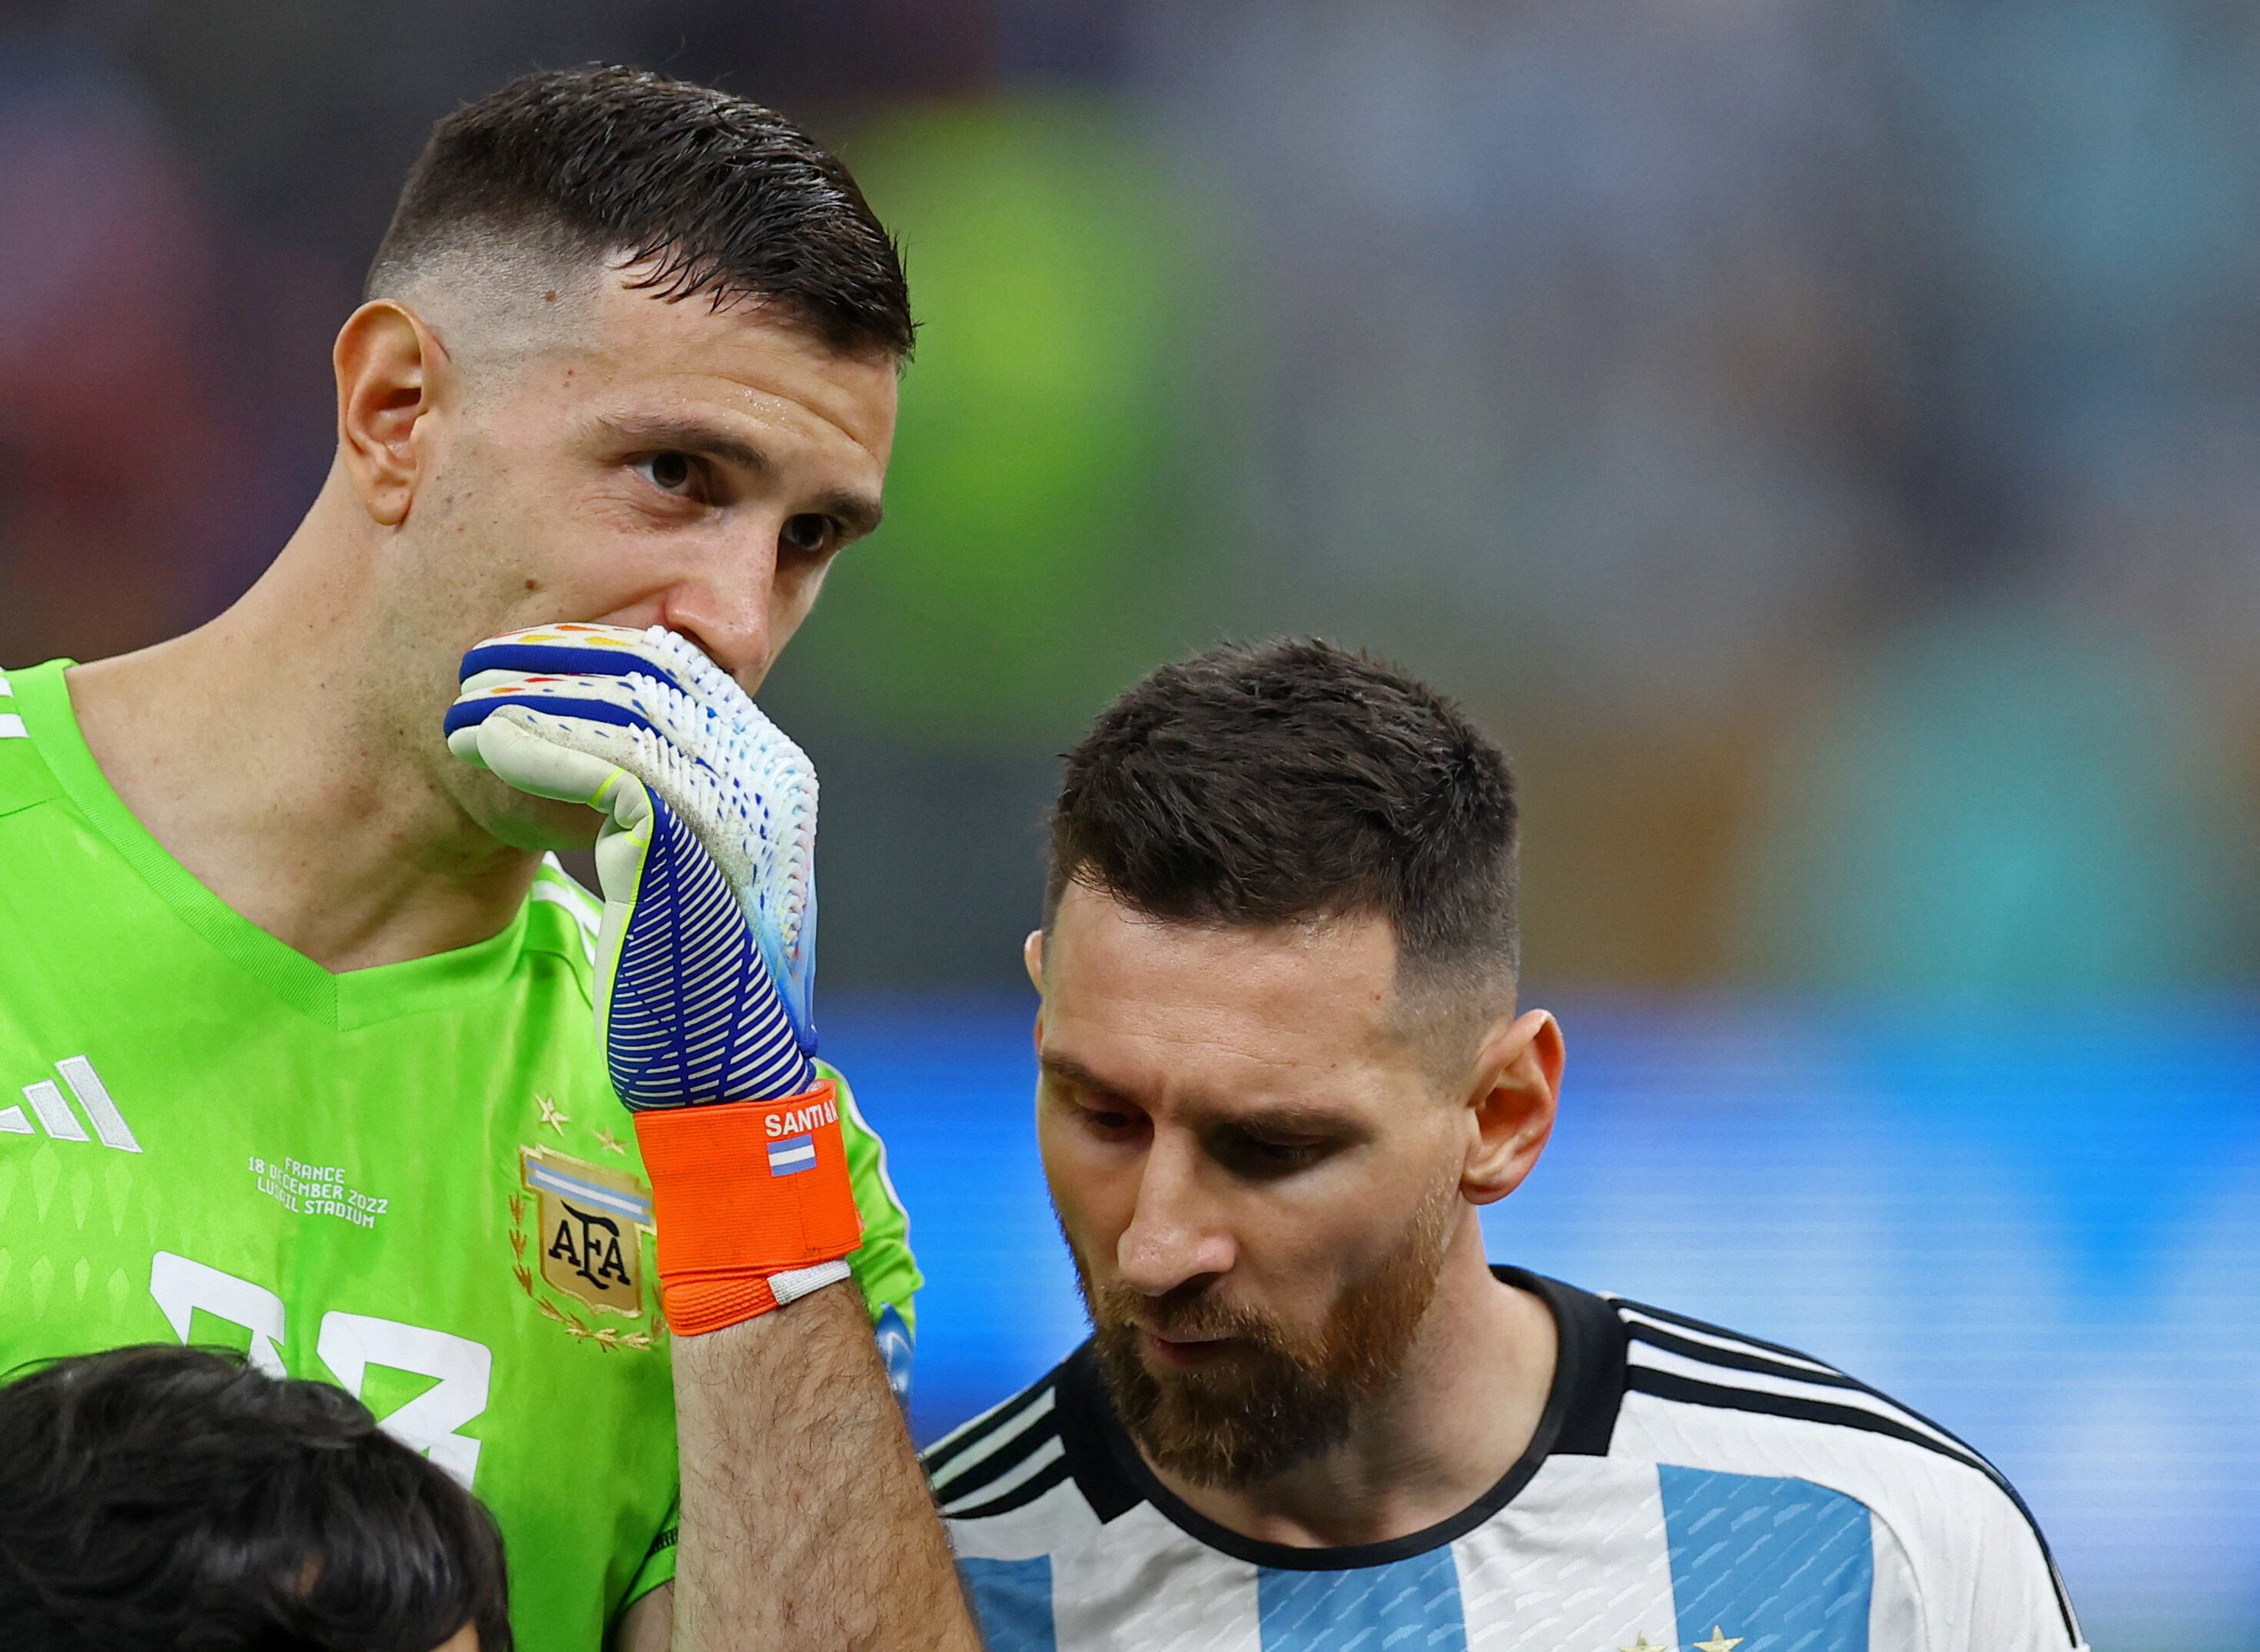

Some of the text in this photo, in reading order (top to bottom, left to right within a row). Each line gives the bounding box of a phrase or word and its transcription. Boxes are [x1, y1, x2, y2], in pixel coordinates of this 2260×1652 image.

[248, 1156, 388, 1213] 18 DECEMBER 2022
[285, 1157, 345, 1183] FRANCE
[304, 1199, 375, 1229] STADIUM
[549, 1200, 632, 1290] AFA
